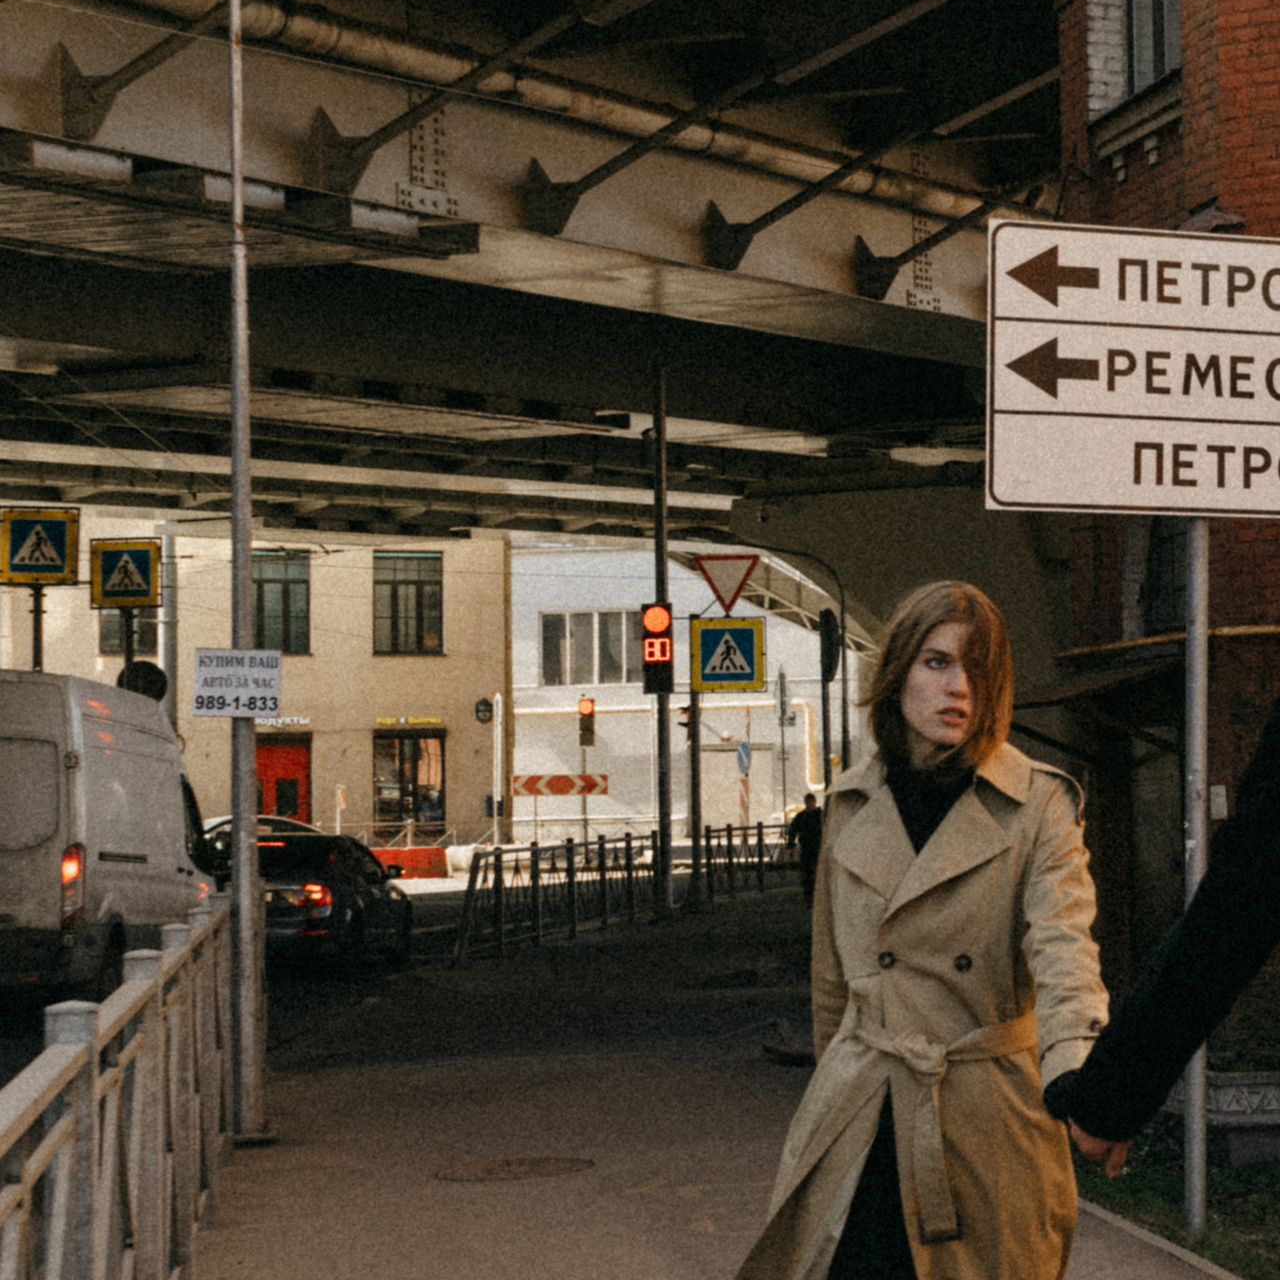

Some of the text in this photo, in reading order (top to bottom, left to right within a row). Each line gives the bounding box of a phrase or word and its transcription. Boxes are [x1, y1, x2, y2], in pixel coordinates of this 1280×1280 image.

[199, 655, 279, 668] КУПИМ ВАШ
[252, 677, 275, 688] ЧАС
[195, 695, 279, 711] 989-1-833
